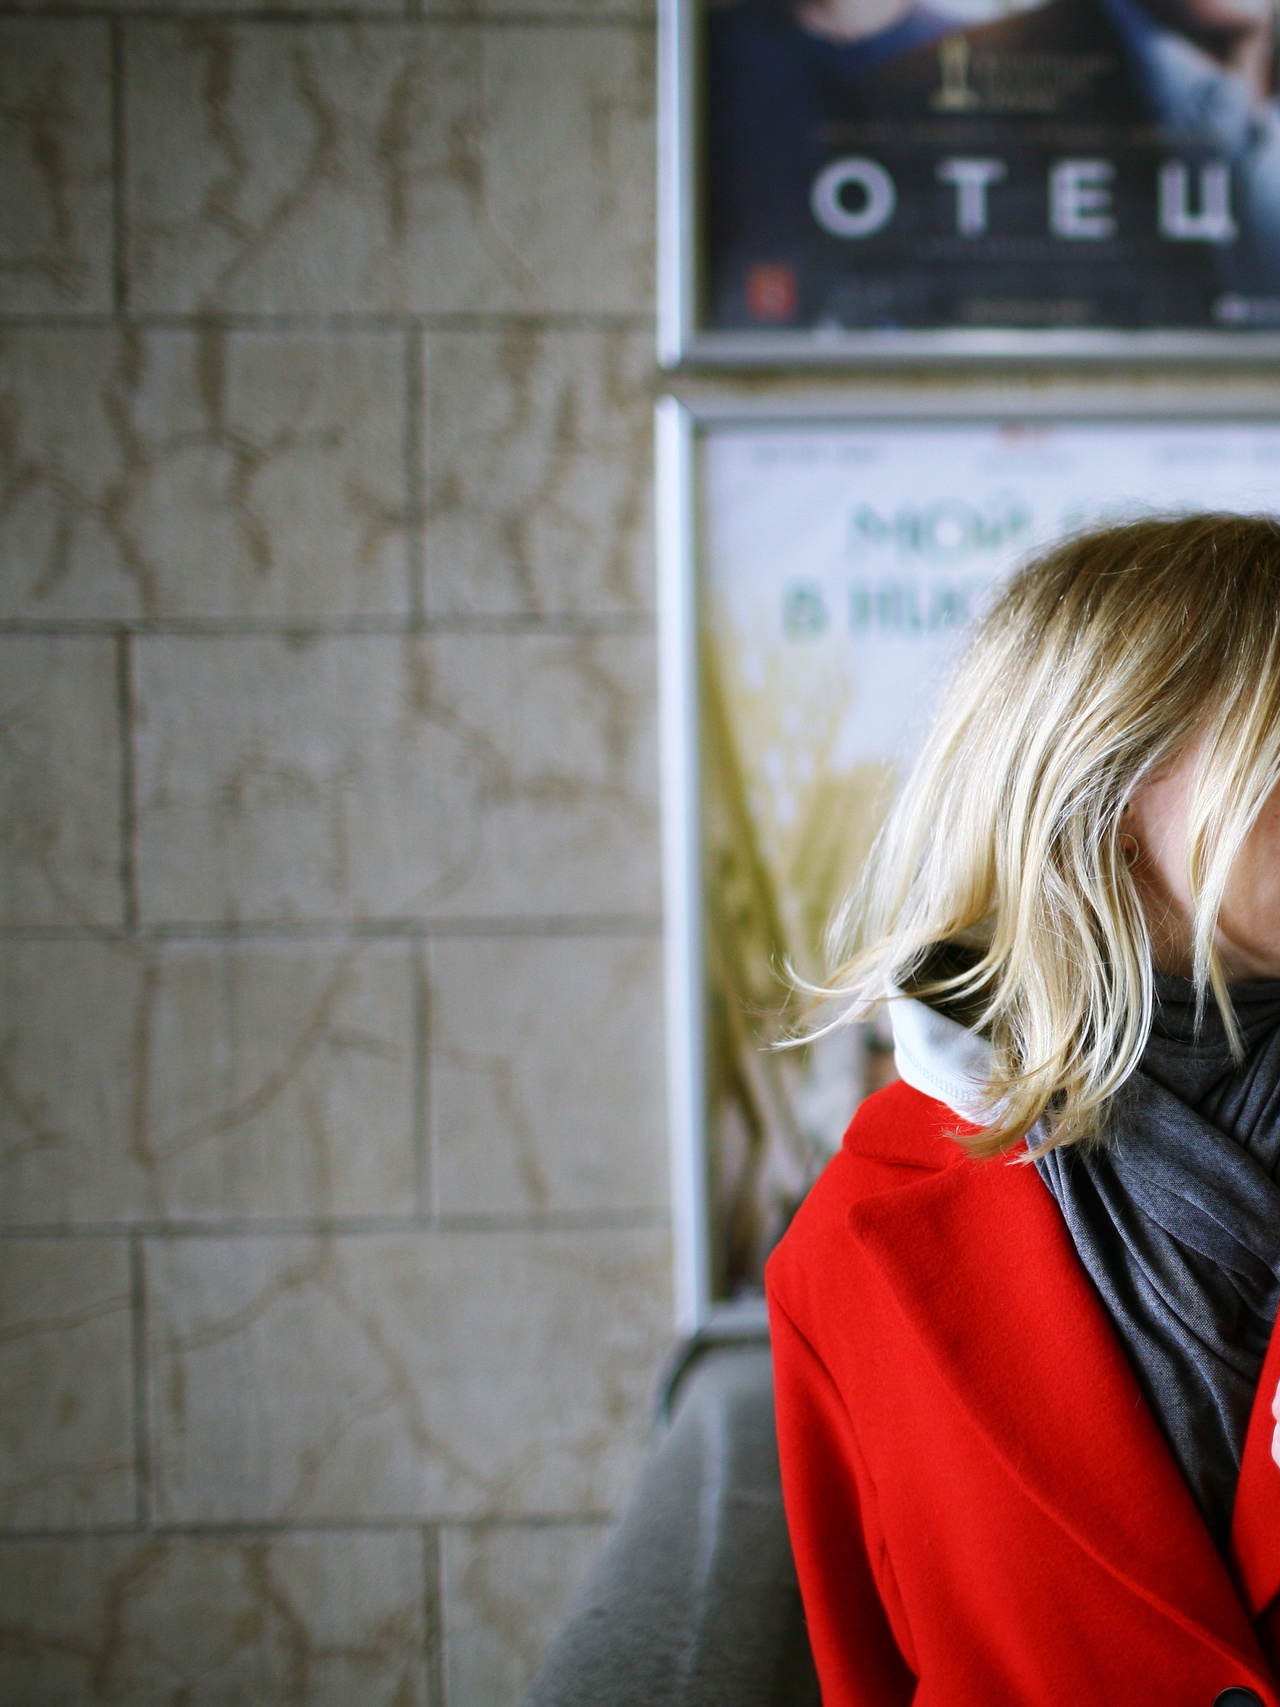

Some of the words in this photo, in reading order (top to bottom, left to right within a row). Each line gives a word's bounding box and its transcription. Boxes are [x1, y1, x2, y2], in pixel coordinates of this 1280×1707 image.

[809, 156, 1238, 242] ОТЕЦ
[850, 492, 1030, 558] МОЙ
[783, 580, 829, 640] В
